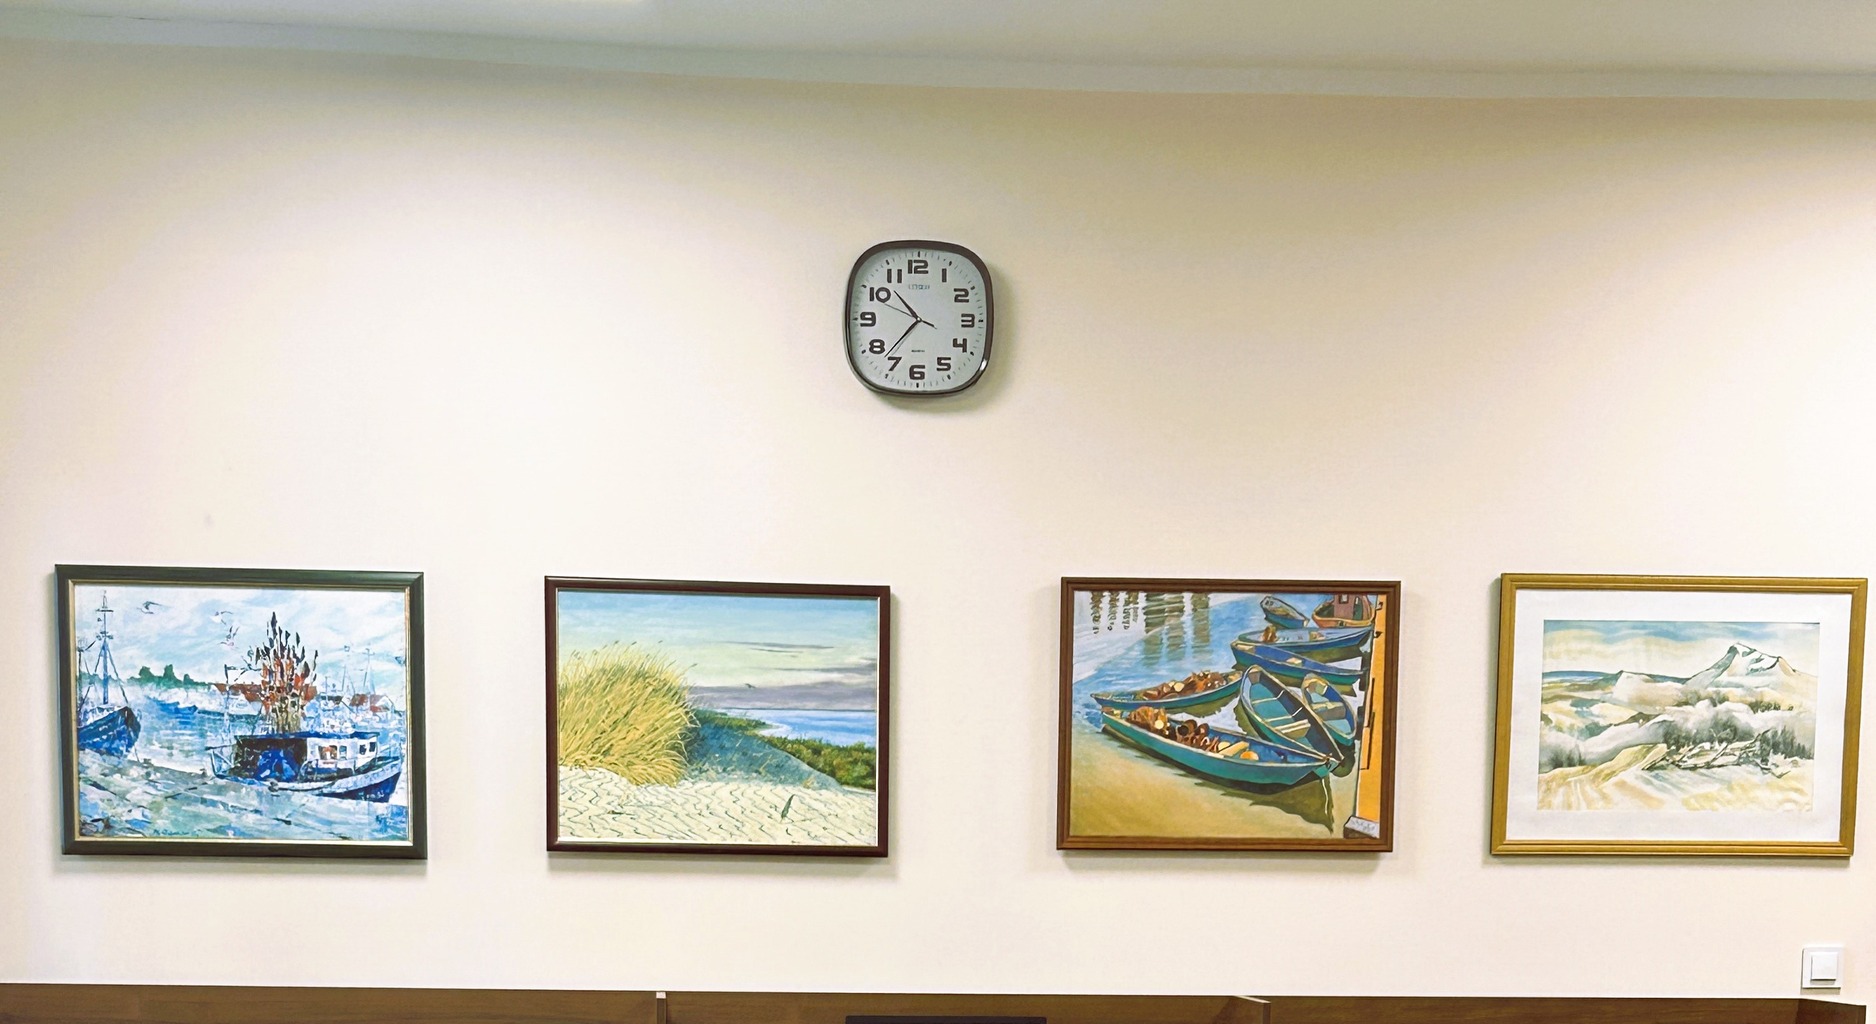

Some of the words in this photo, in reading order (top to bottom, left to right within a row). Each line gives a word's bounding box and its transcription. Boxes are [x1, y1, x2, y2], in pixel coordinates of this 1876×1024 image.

[908, 260, 928, 274] 12
[887, 269, 902, 283] 11
[942, 268, 947, 282] 1
[870, 287, 891, 303] 10
[954, 288, 970, 303] 2
[860, 312, 876, 327] 9
[961, 313, 975, 328] 3
[869, 339, 885, 354] 8
[953, 338, 967, 353] 4
[888, 356, 902, 371] 7
[937, 357, 951, 371] 5
[909, 365, 925, 380] 6
